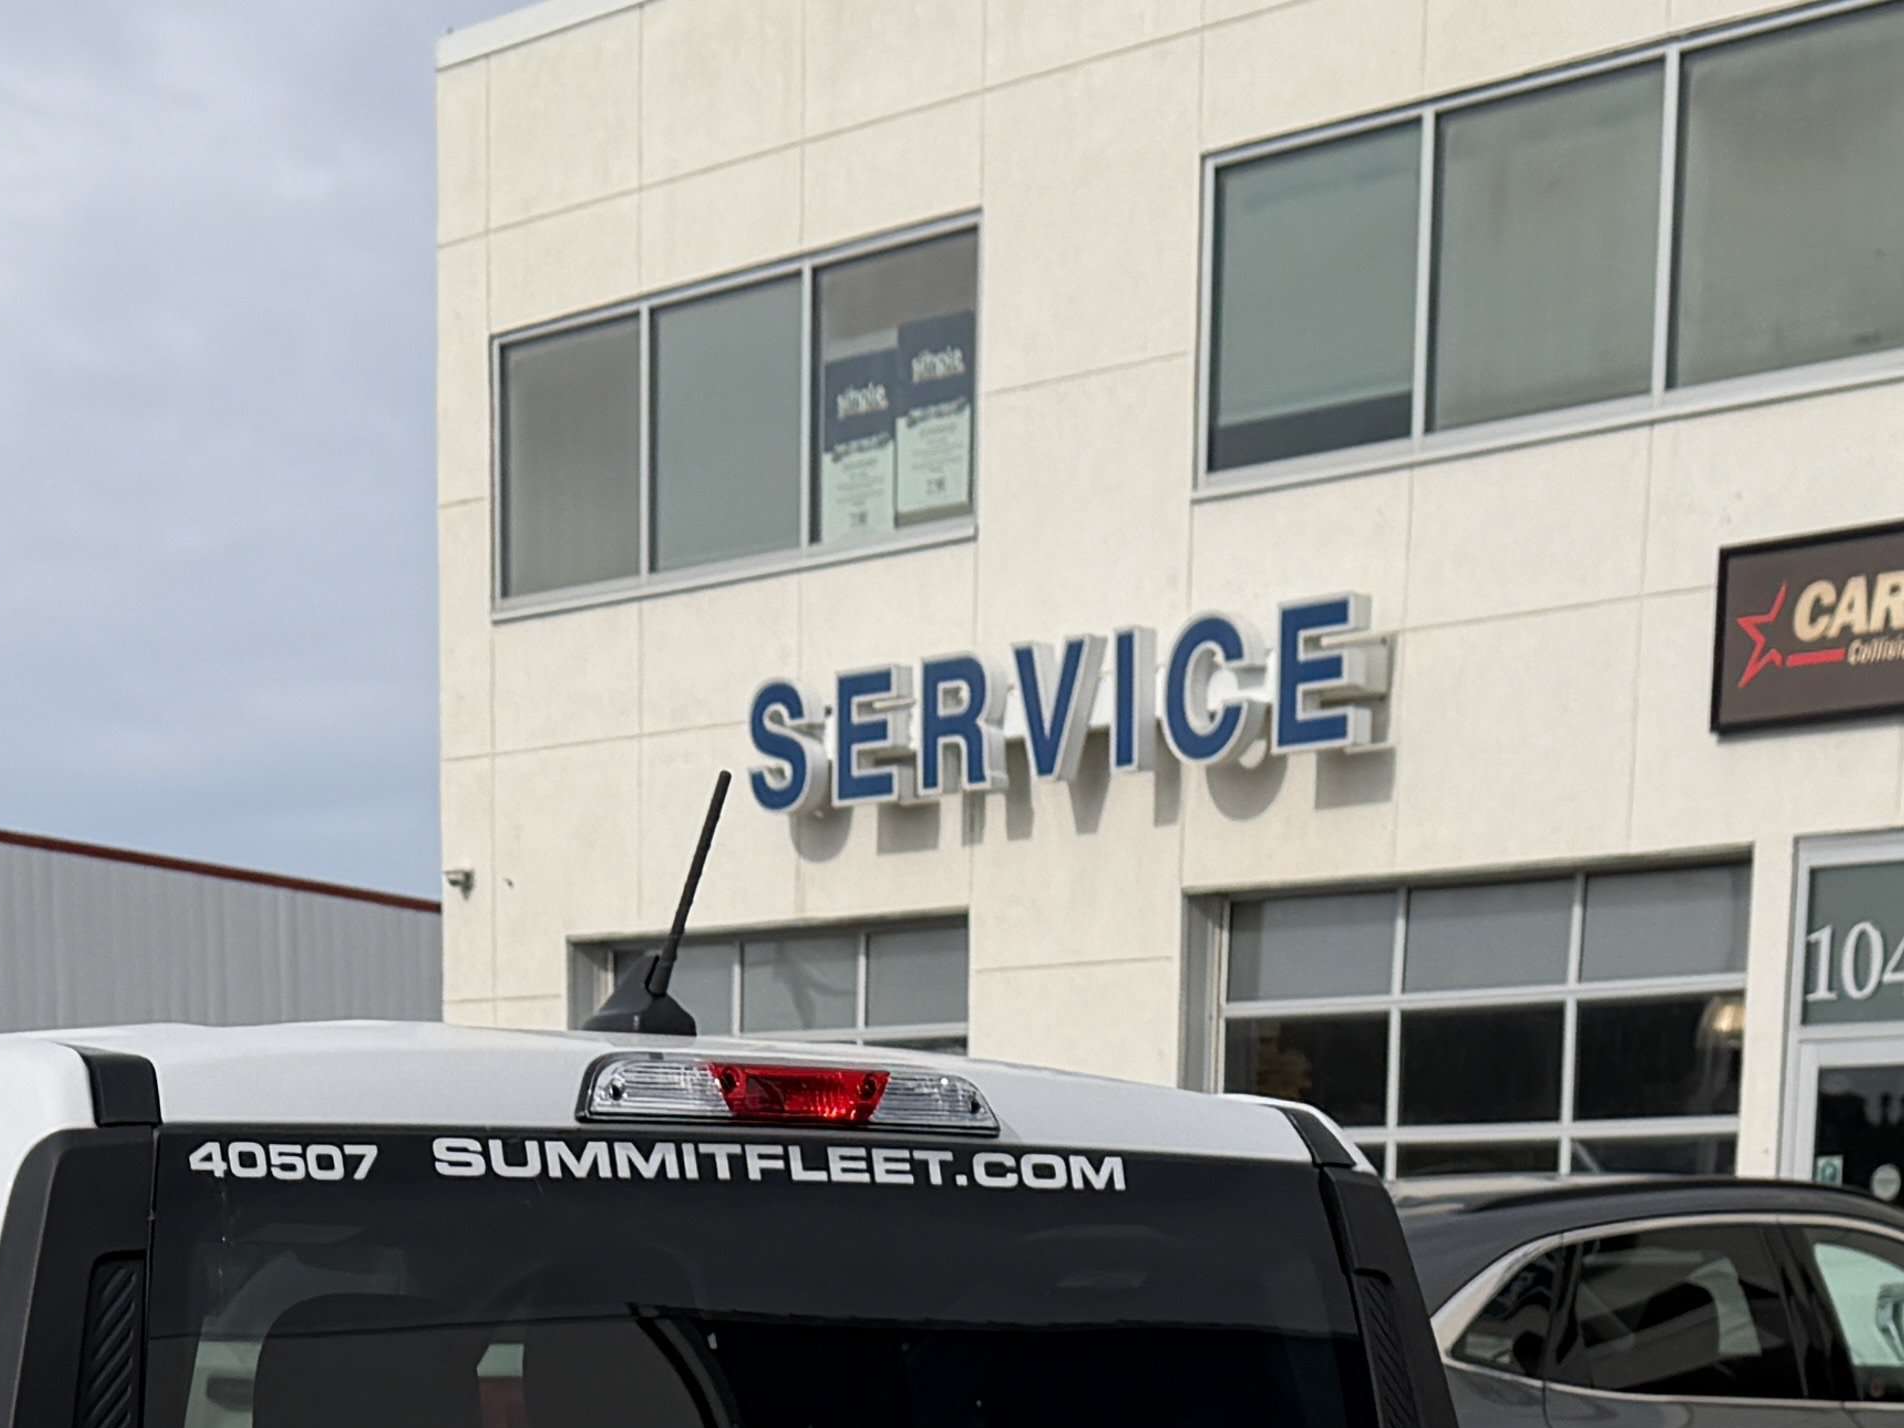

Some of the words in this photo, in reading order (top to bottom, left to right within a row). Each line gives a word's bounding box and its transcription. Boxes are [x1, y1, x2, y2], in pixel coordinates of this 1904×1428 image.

[748, 592, 1362, 813] SERVICE
[188, 1141, 379, 1181] 40507
[433, 1136, 1127, 1192] SUMMITFLEET.COM
